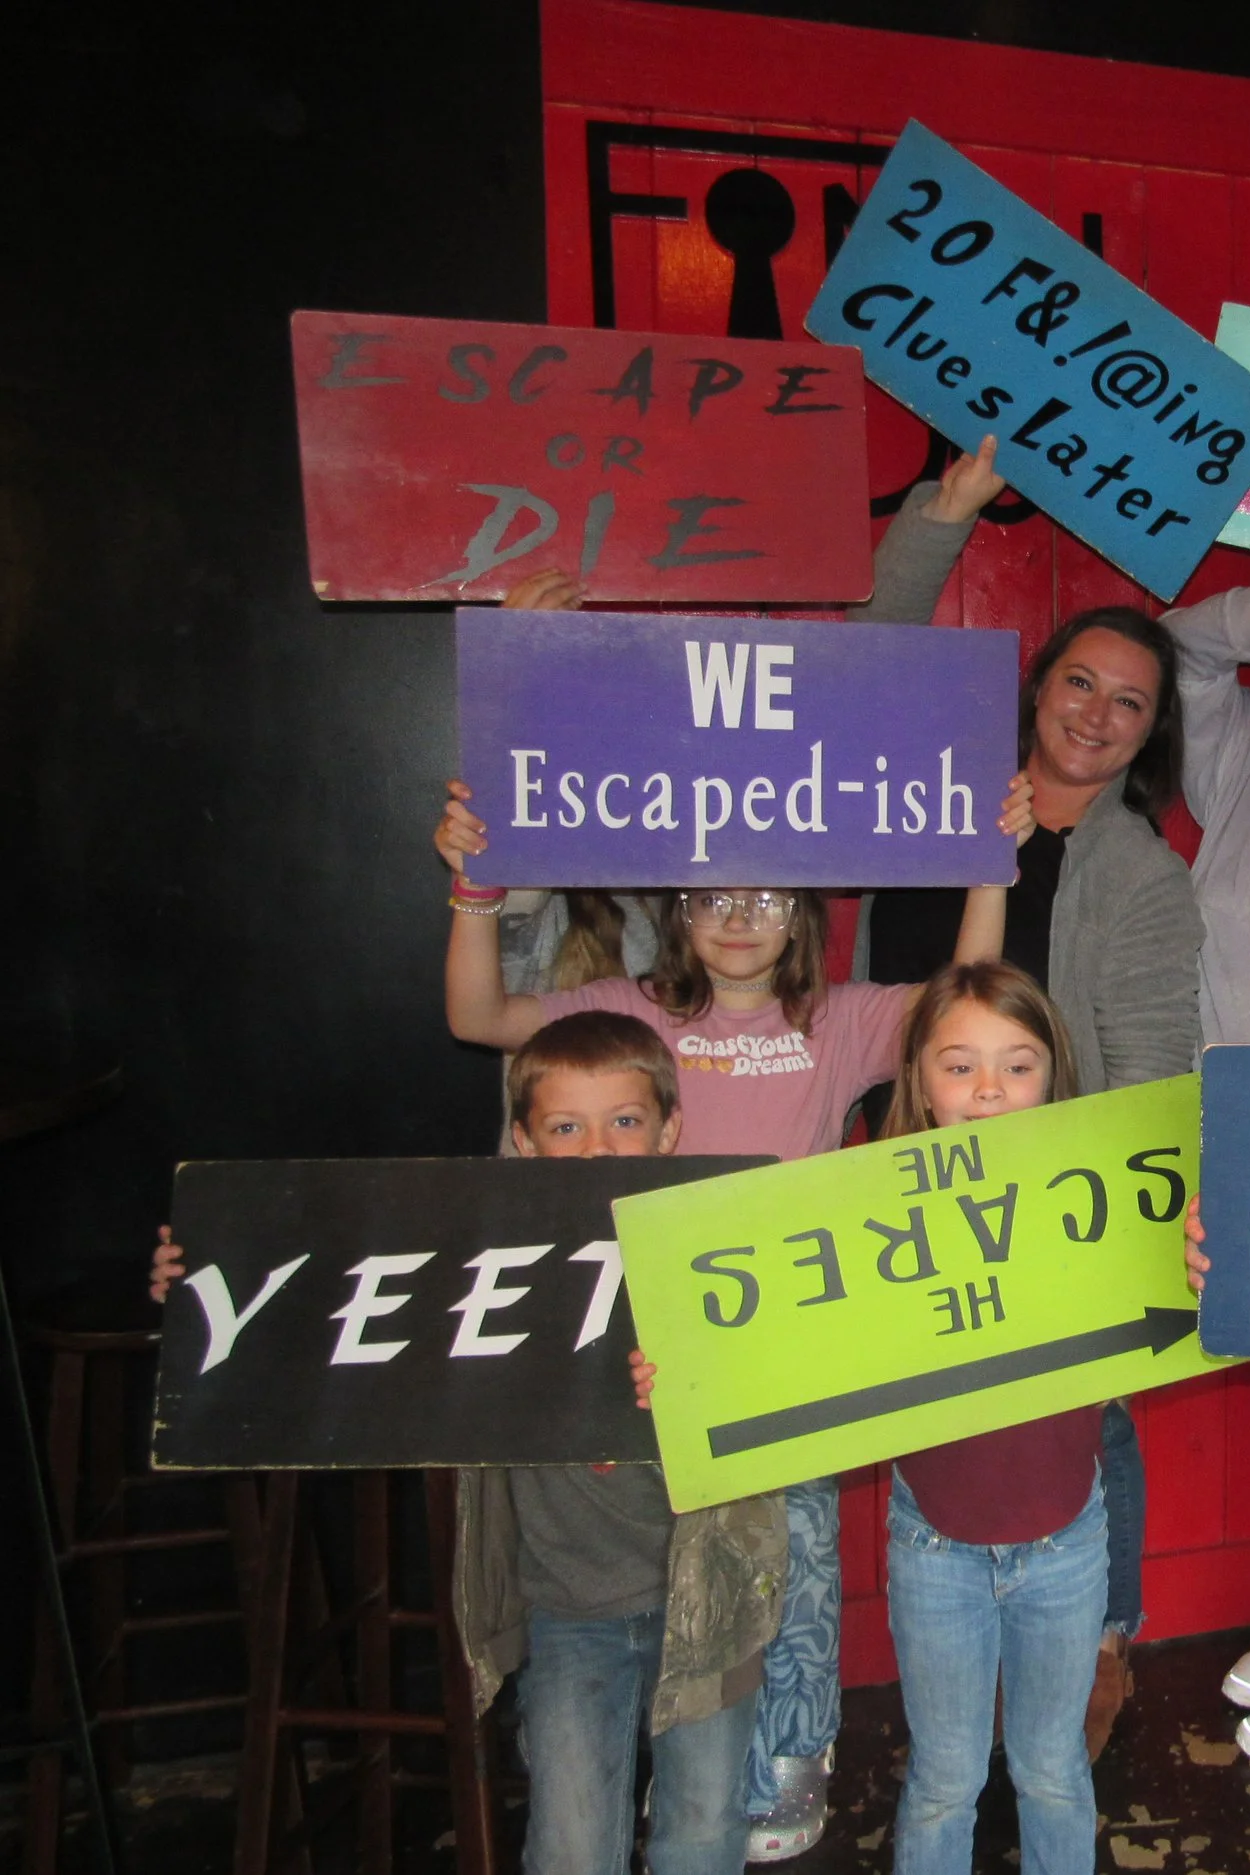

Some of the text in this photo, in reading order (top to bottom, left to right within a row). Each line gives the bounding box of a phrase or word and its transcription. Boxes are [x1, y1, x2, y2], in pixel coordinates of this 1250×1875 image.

[886, 180, 994, 266] 20
[314, 332, 844, 422] ESCAPE
[841, 284, 1014, 419] Clues
[1010, 397, 1191, 537] Later
[545, 433, 646, 475] OR
[404, 483, 775, 590] DIE
[685, 641, 794, 730] WE
[510, 741, 978, 862] Escaped-ish
[677, 1032, 806, 1060] Chase Your
[730, 1051, 814, 1077] Dreams
[893, 1135, 985, 1197] ME
[690, 1146, 1186, 1328] SCARES
[183, 1240, 625, 1375] YEET
[927, 1275, 1006, 1337] HE
